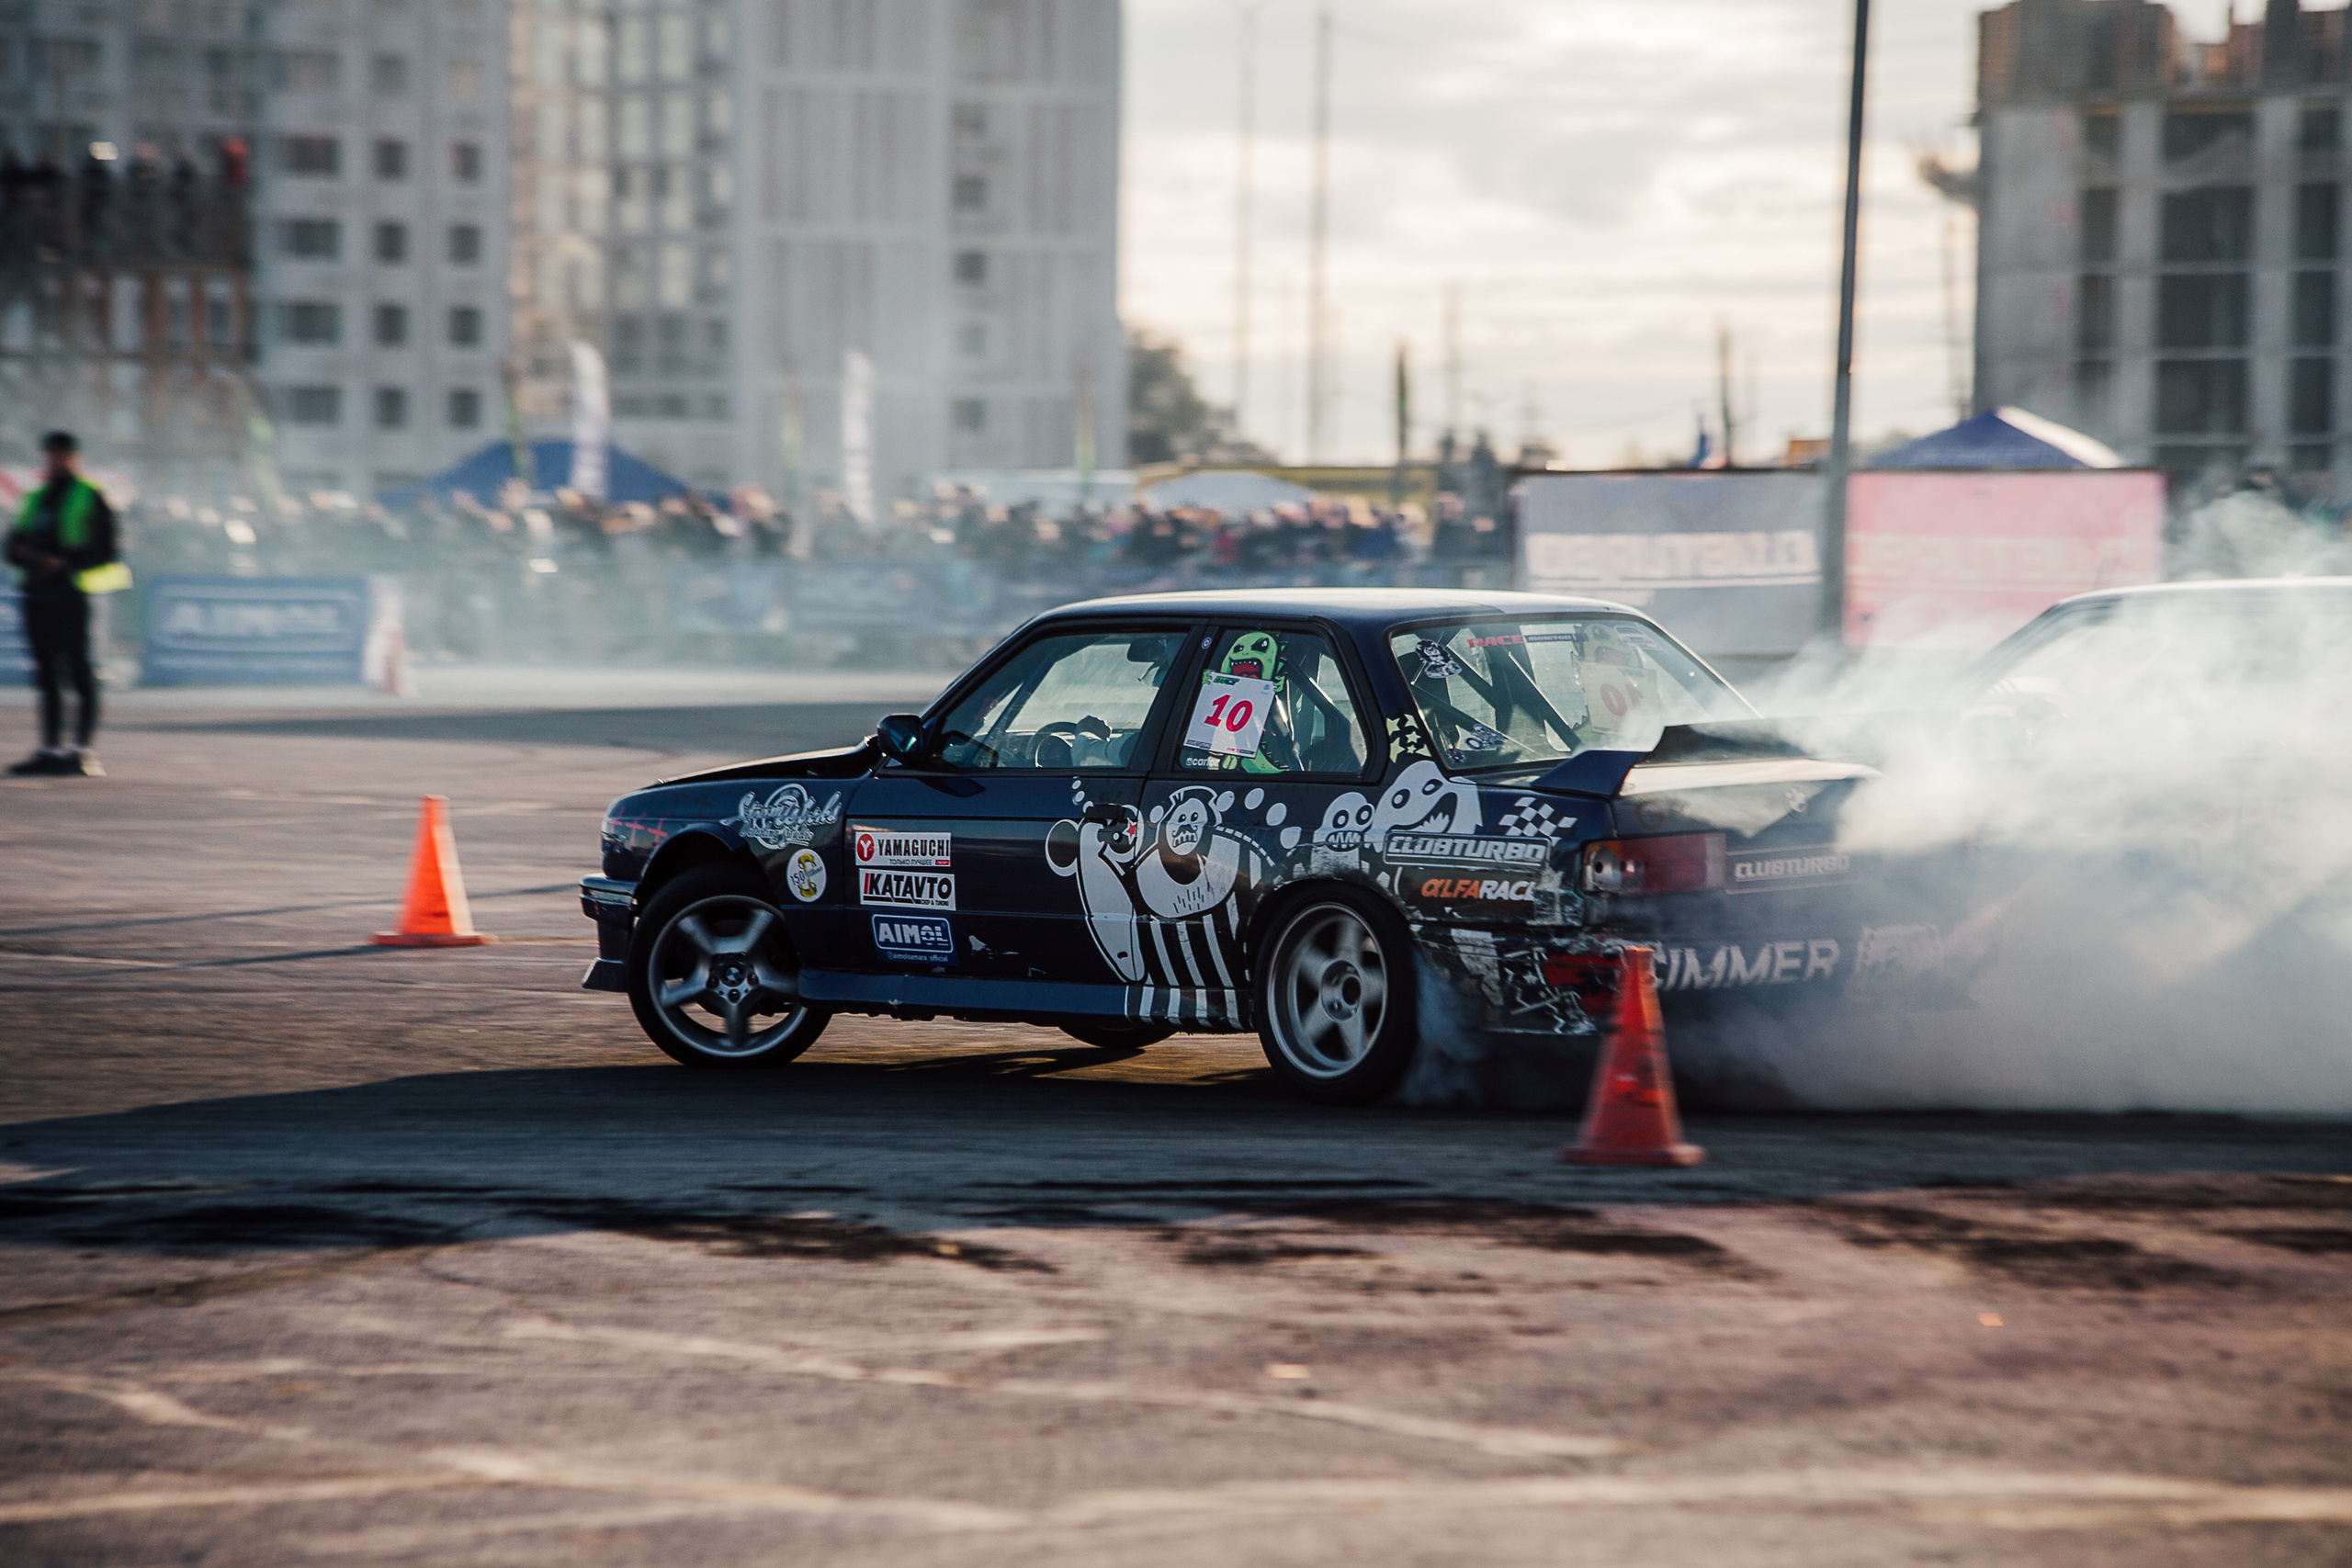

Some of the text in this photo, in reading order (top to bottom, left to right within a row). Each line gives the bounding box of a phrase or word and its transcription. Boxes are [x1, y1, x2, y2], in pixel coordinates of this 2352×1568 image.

[1467, 635, 1525, 649] RACE
[1204, 694, 1253, 732] 10
[877, 839, 949, 857] YAMAGUCHI
[1388, 836, 1546, 863] CLUBTURBO
[878, 923, 949, 946] AIMOL
